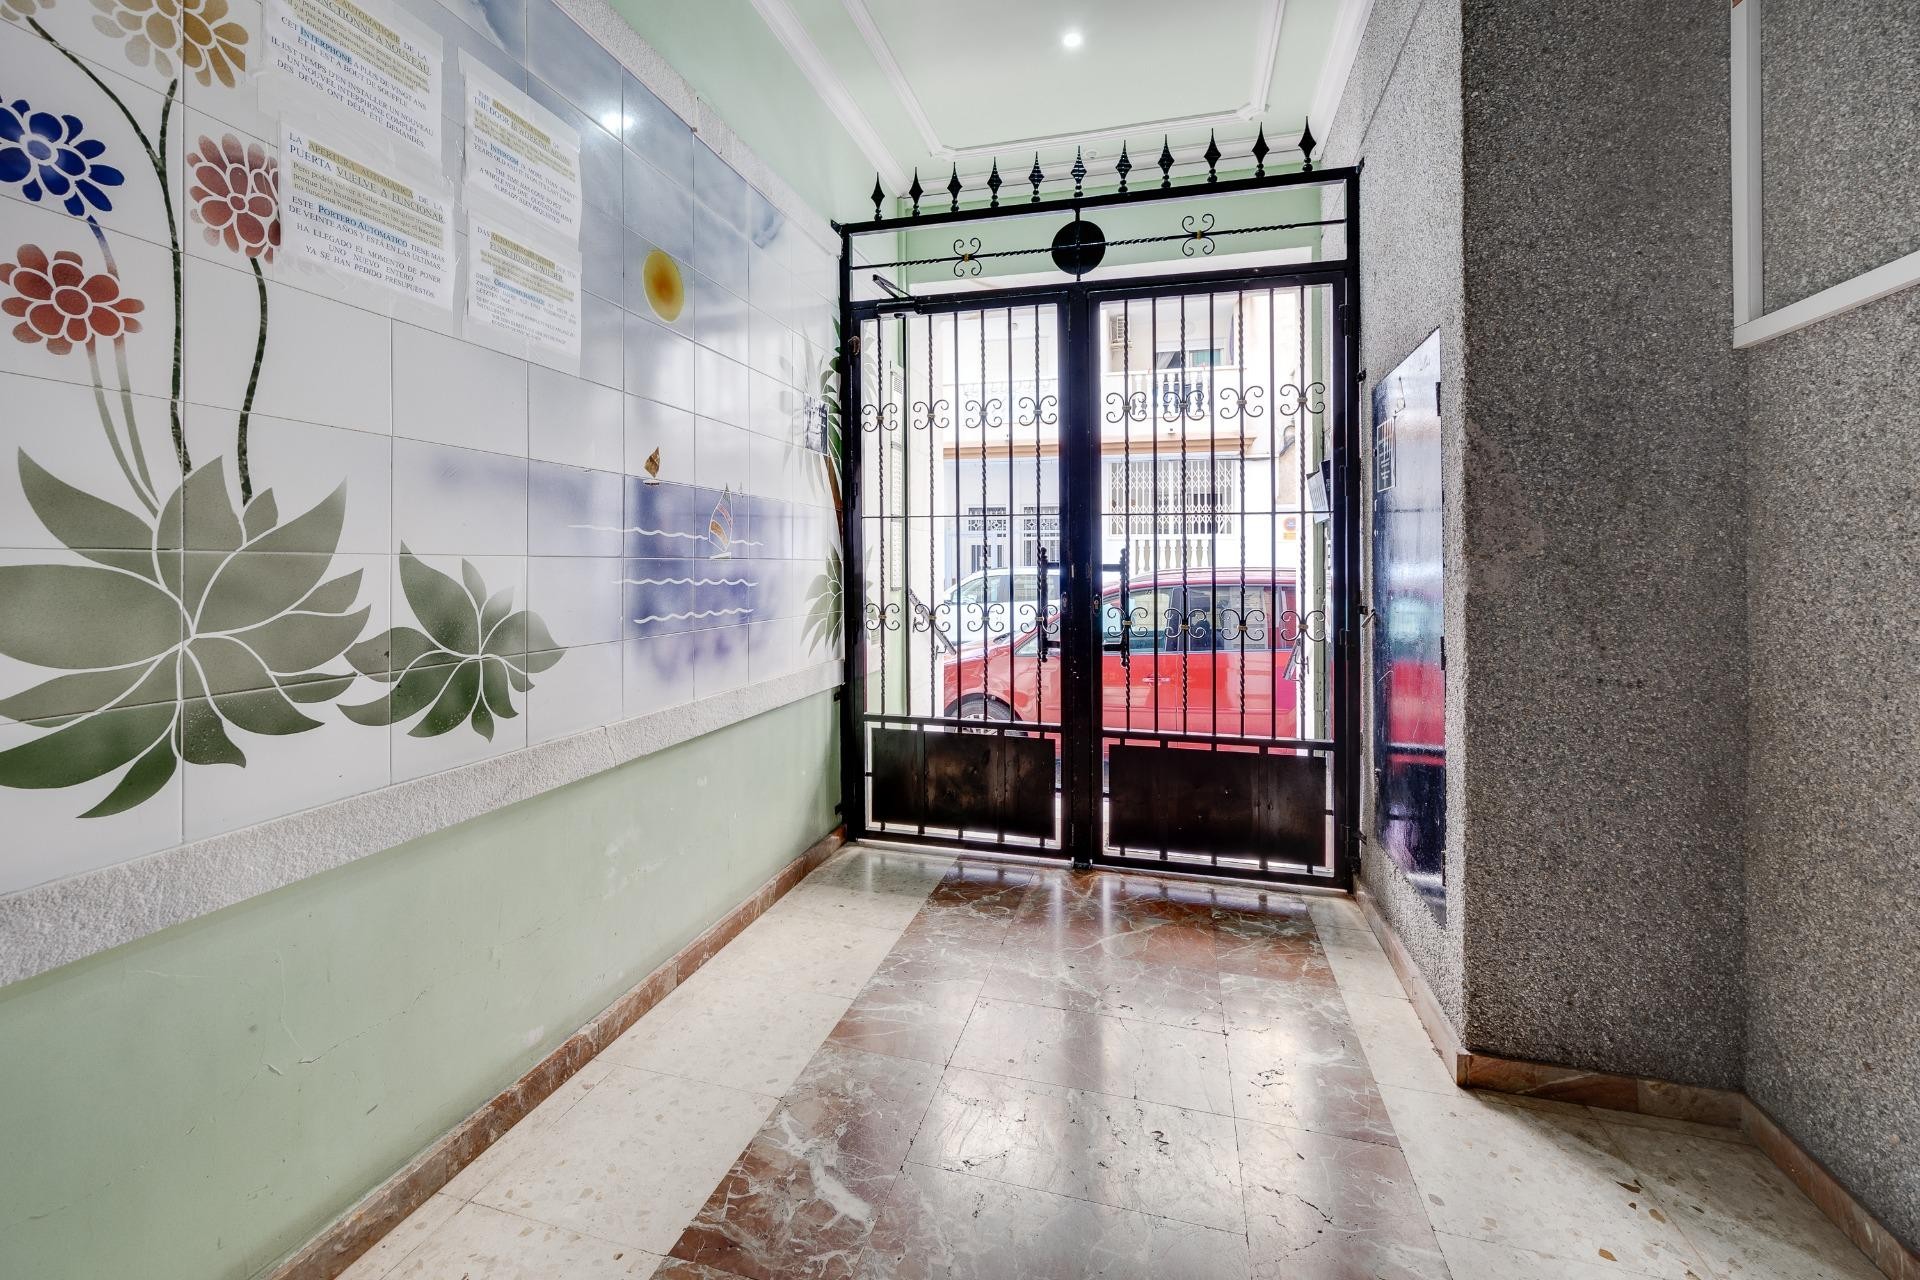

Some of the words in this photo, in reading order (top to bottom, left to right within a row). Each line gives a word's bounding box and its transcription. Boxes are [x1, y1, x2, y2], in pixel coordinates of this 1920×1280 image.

[281, 16, 296, 31] CET
[300, 25, 352, 65] INTERPHONE
[360, 64, 377, 81] PLUS
[391, 83, 411, 101] VINGT
[404, 42, 413, 52] DE
[417, 51, 427, 62] LA
[277, 58, 293, 74] DES
[298, 70, 323, 91] DEVIS
[327, 87, 343, 102] ONT
[282, 41, 298, 57] EST
[299, 52, 326, 73] TEMPS
[348, 80, 386, 109] INSTALLER
[301, 63, 335, 88] NOUVEL
[343, 64, 363, 81] BOUT
[473, 96, 487, 111] THE
[308, 141, 353, 170] APERTURA
[473, 142, 492, 158] YEARS
[493, 154, 504, 165] OLD
[290, 143, 331, 171] PUERTA
[336, 166, 376, 193] VUELVE
[293, 162, 309, 176] Pero
[293, 172, 317, 189] porque
[337, 199, 351, 211] bien
[292, 195, 312, 210] ESTE
[318, 204, 356, 227] PORTERO
[357, 219, 407, 248] AUTOMÁTICO
[411, 243, 429, 256] TIENE
[303, 210, 334, 228] VEINTE
[336, 221, 357, 237] AÑOS
[397, 247, 410, 257] LAS
[477, 226, 490, 238] DAS
[313, 228, 351, 249] LLEGADO
[368, 250, 404, 269] MOMENTO
[419, 270, 440, 283] PONER
[328, 244, 345, 256] UNO
[353, 253, 379, 269] NUEVO
[334, 255, 350, 268] HAN
[354, 263, 381, 279] PEDIDO
